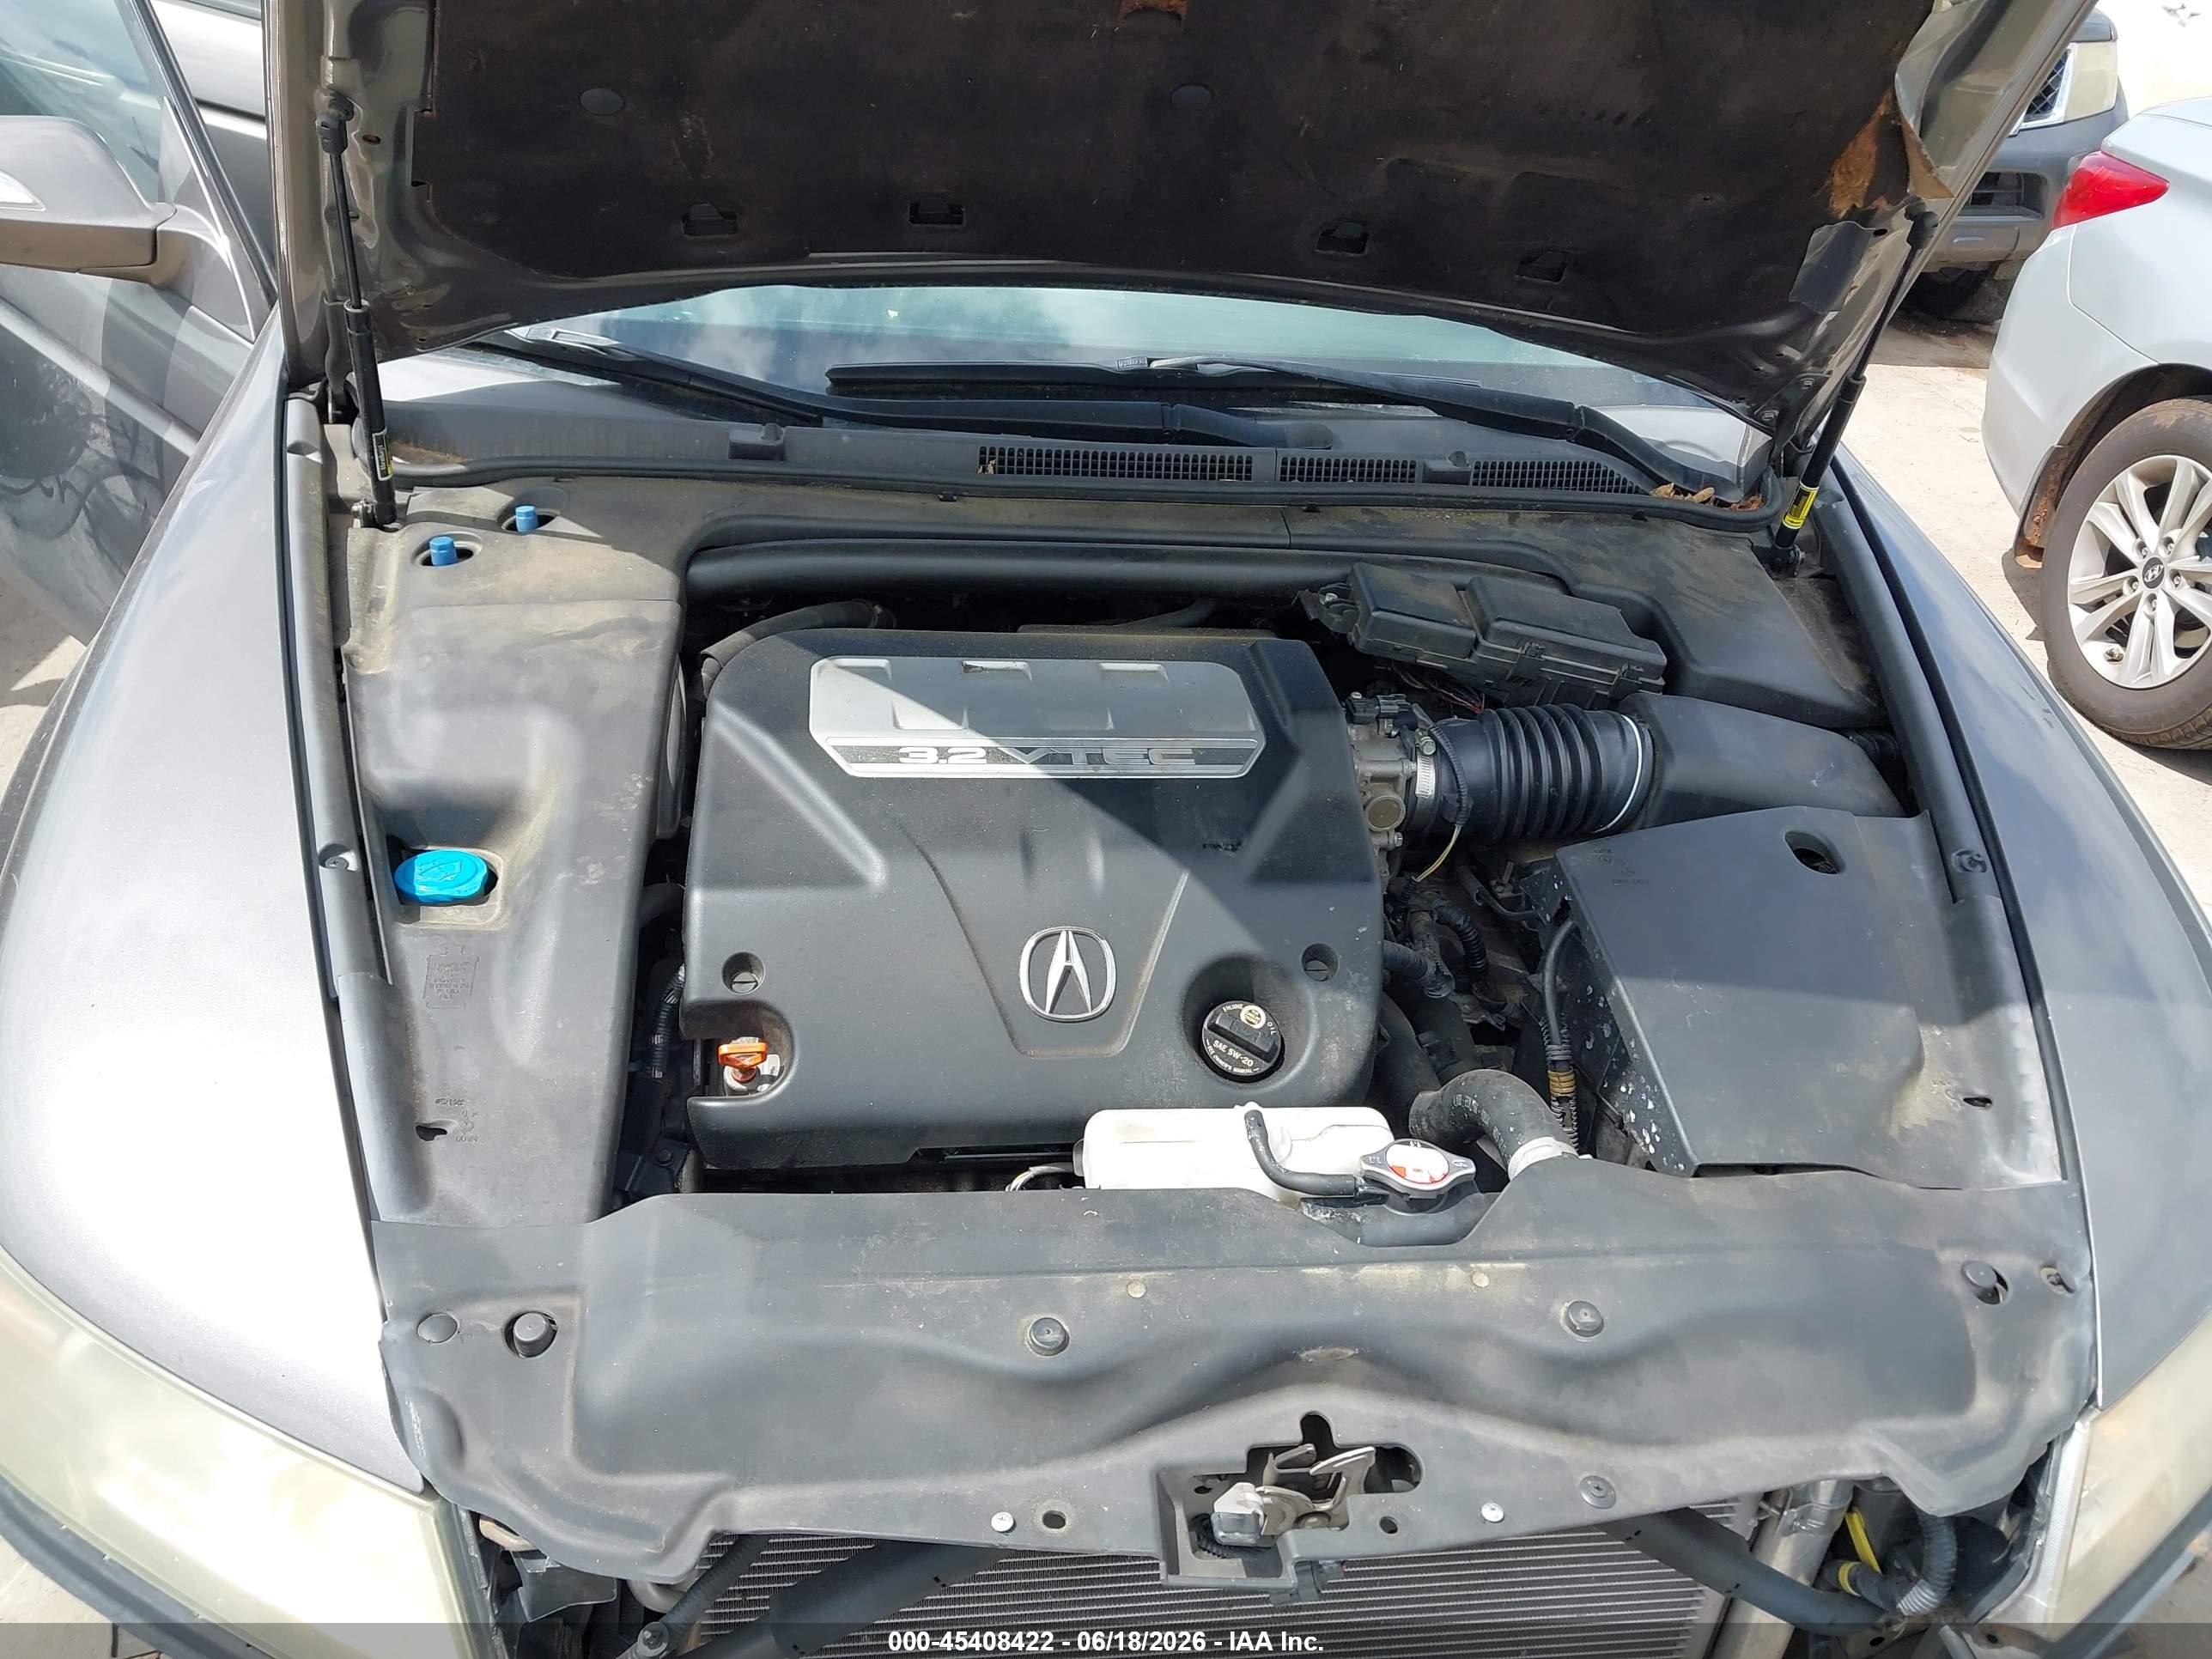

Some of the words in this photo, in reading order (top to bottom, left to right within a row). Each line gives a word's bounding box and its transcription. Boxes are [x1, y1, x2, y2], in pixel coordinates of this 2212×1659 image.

[898, 746, 988, 764] 3.2
[997, 747, 1196, 765] VTEC
[1267, 1021, 1278, 1036] OIL
[1212, 1040, 1228, 1053] SAE
[1227, 1048, 1254, 1066] 5W-20
